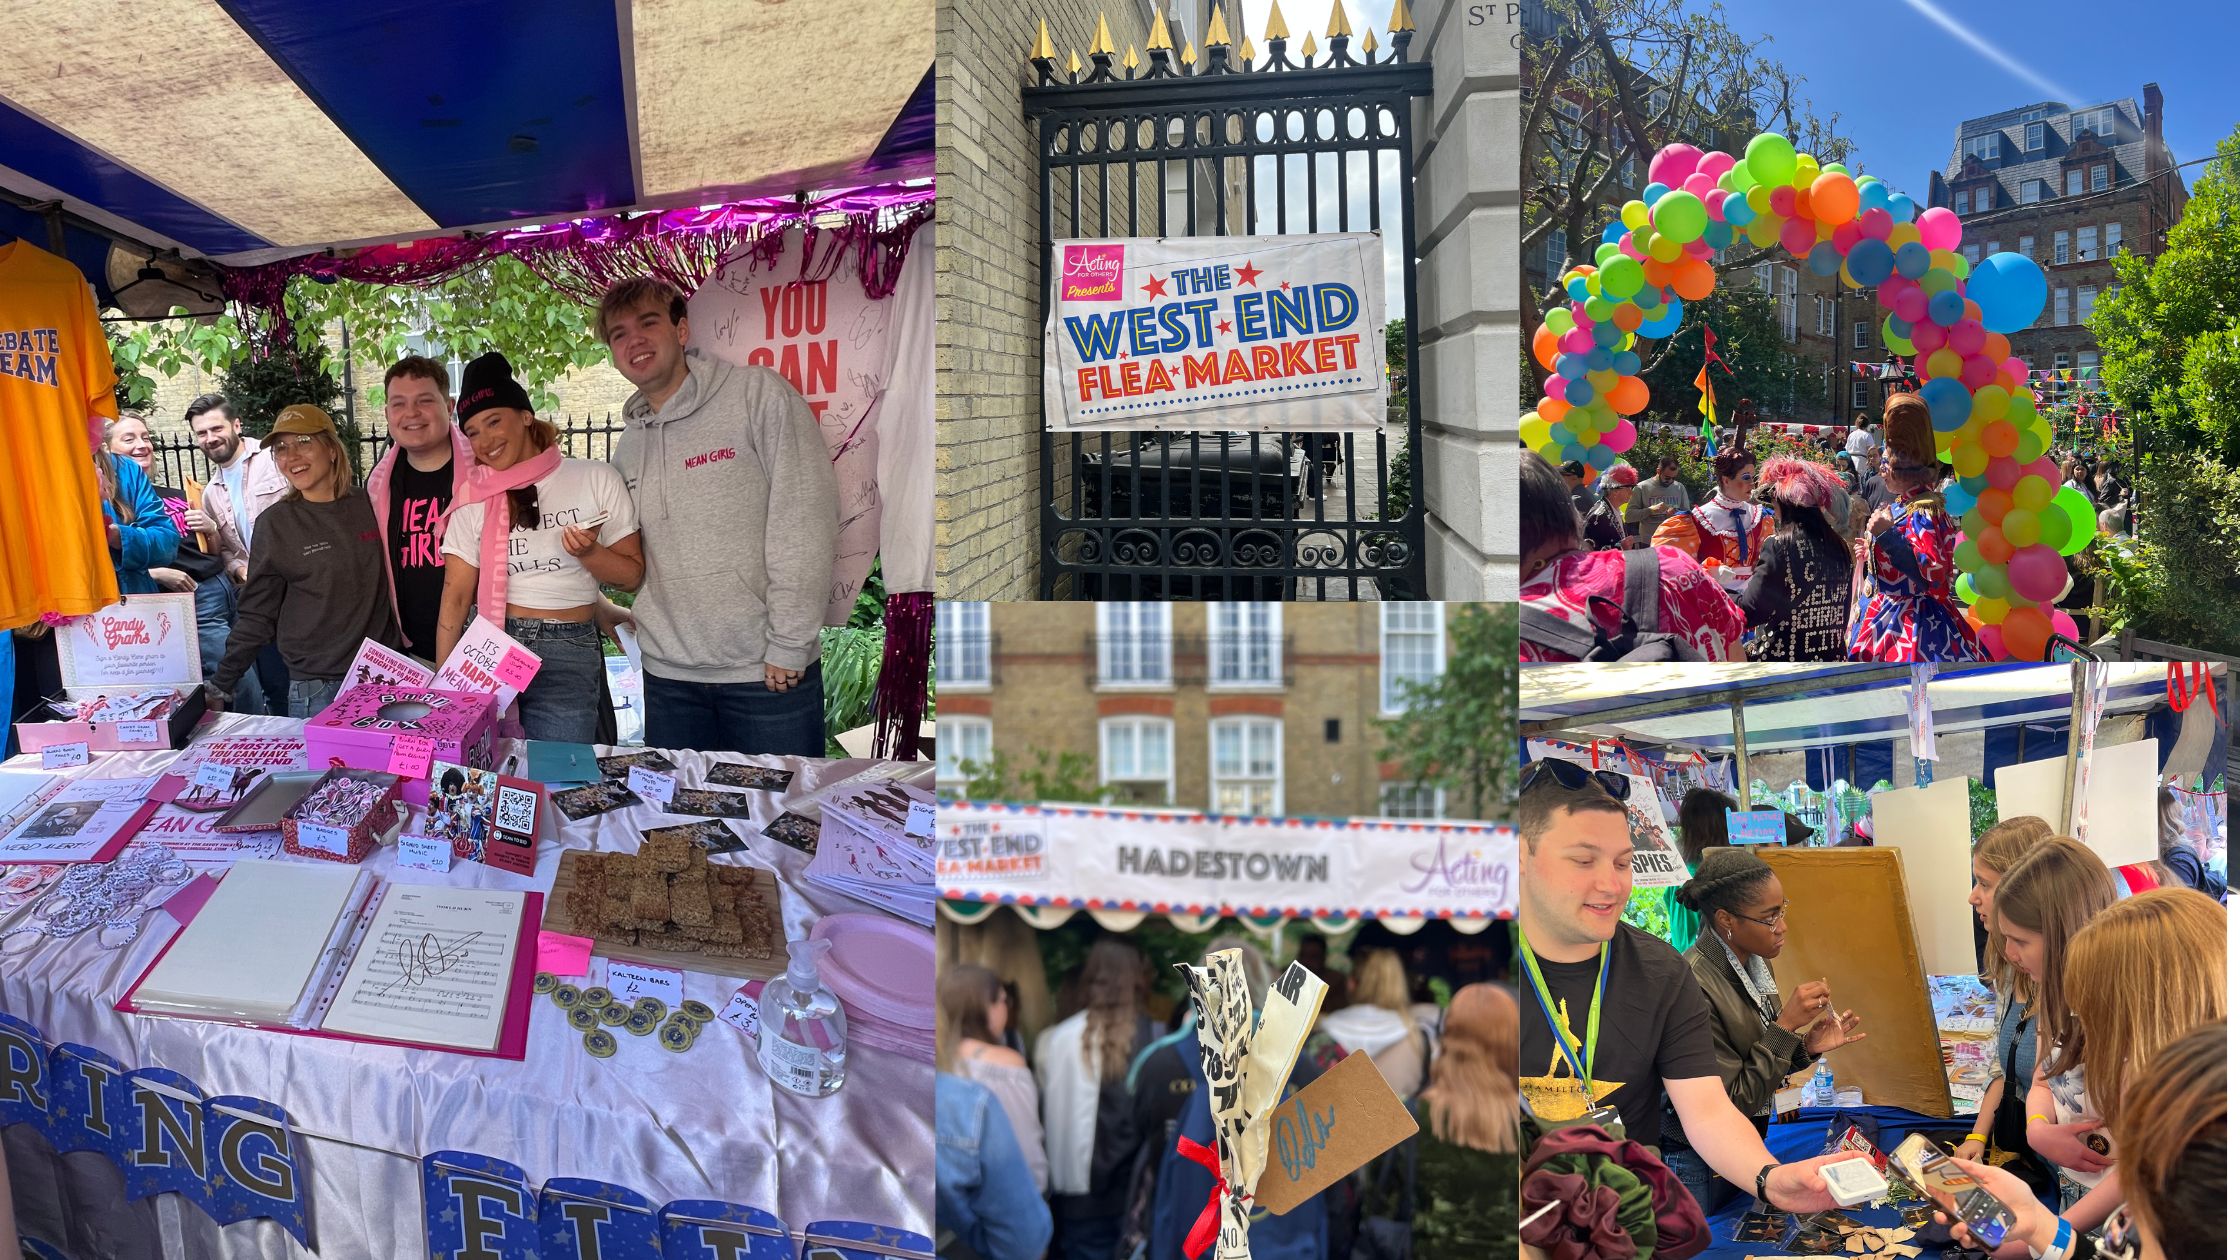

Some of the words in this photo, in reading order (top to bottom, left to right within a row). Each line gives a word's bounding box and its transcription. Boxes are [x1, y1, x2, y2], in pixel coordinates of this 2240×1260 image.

[1067, 246, 1120, 274] Acting
[1088, 270, 1113, 278] OTHERS
[1171, 263, 1231, 296] THE
[1066, 282, 1116, 299] Presents
[759, 280, 827, 340] YOU
[1063, 297, 1219, 364] WEST
[1233, 281, 1360, 343] END
[1076, 358, 1176, 403] FLEA
[1181, 333, 1361, 389] MARKET
[684, 453, 708, 470] MEAN
[708, 447, 736, 463] GIRLS
[402, 496, 445, 533] EA
[102, 616, 146, 632] Candy
[104, 630, 151, 650] Grams
[481, 638, 500, 656] IT'S
[367, 646, 386, 660] GONNA
[384, 656, 399, 667] FIND
[397, 661, 409, 672] OUT
[463, 644, 498, 672] OCTOBE
[363, 652, 398, 674] NAUGHTY
[403, 675, 423, 687] NICE
[459, 659, 502, 694] HAPPY
[207, 742, 229, 750] THE
[228, 742, 274, 750] MOST
[274, 742, 305, 750] FUN
[210, 750, 236, 758] YOU
[237, 750, 259, 758] CAN
[259, 750, 289, 758] HAVE
[220, 757, 264, 765] WEST
[264, 757, 294, 765] END
[139, 815, 196, 833] EAN
[964, 822, 990, 836] THE
[990, 833, 1043, 855] END
[936, 859, 961, 874] EA
[967, 854, 1042, 874] MARKET
[1117, 846, 1329, 883] HADESTOWN
[1400, 834, 1510, 909] Acting
[612, 970, 648, 983] KALTEEN
[649, 976, 670, 987] BARS
[626, 981, 641, 993] £2
[734, 997, 758, 1013] OPENI
[1523, 1083, 1583, 1094] HAMILTO
